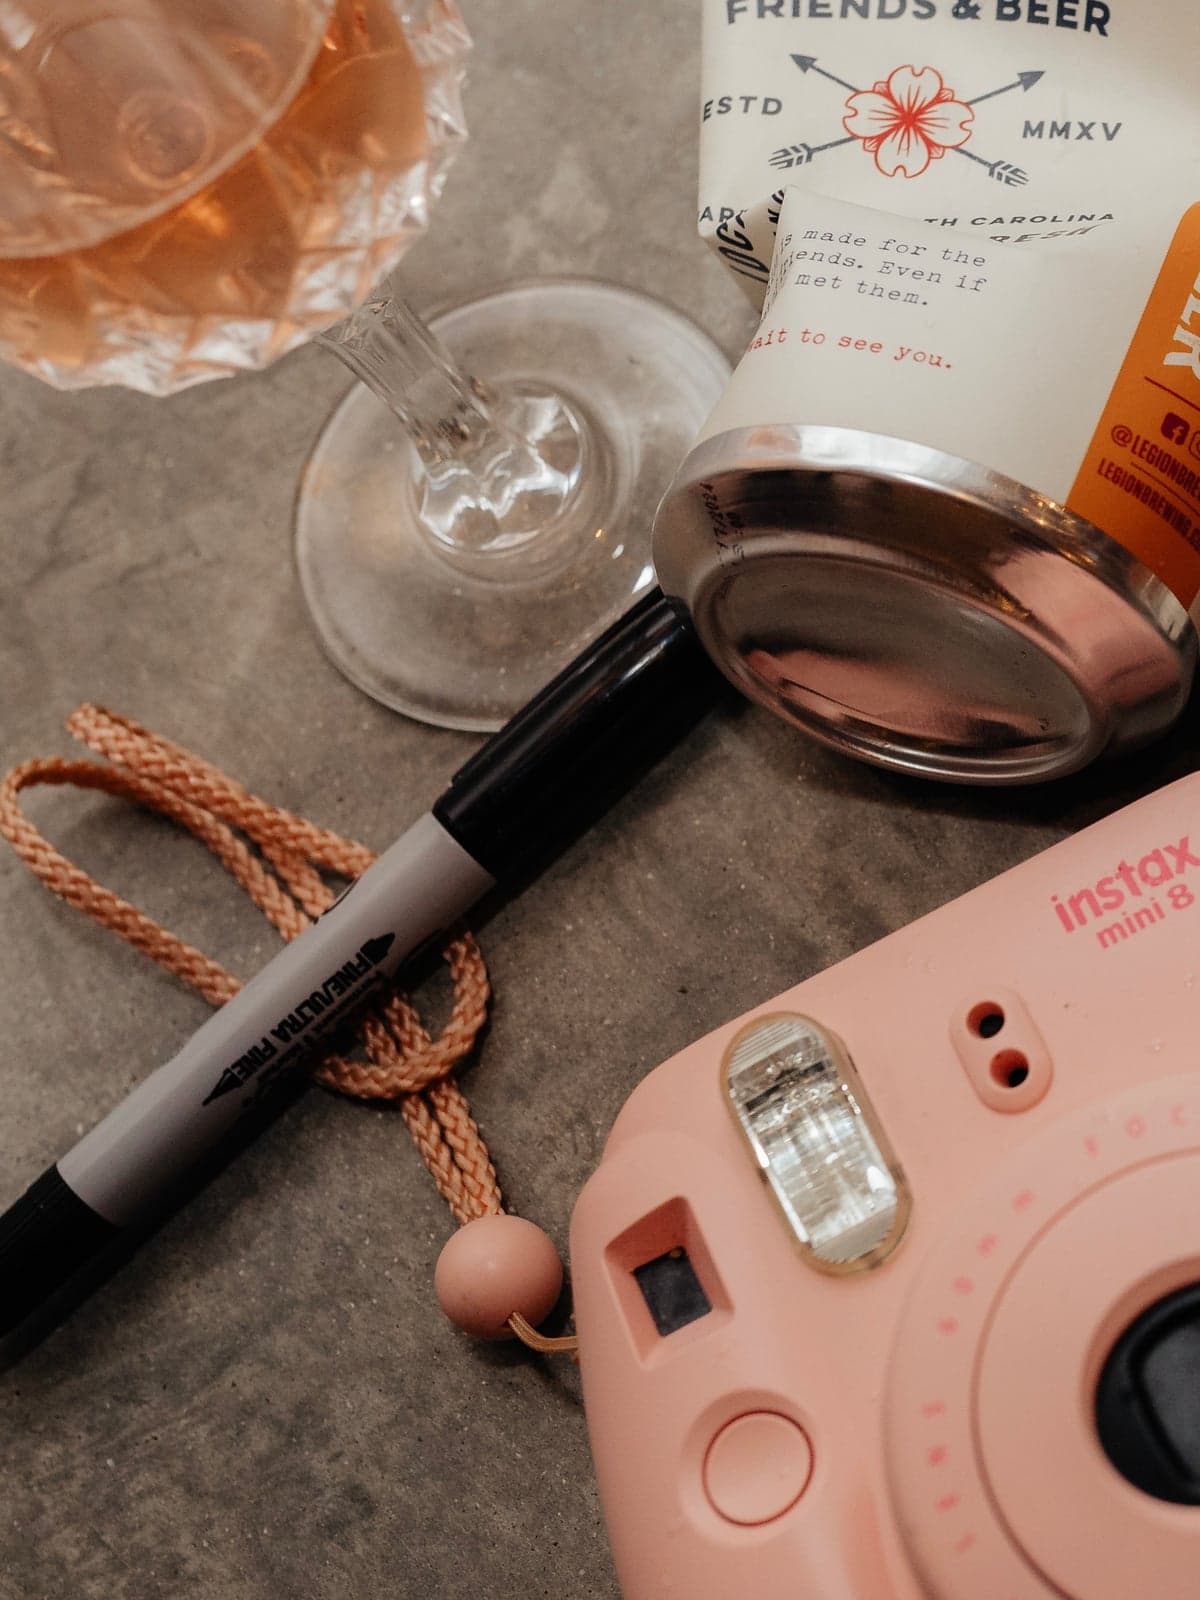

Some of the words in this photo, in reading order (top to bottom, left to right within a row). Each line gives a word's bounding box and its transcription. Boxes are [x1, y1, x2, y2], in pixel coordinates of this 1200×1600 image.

[726, 0, 937, 24] FRIENDS
[951, 0, 982, 20] &
[994, 0, 1111, 38] BEER
[703, 95, 783, 122] ESTD
[1022, 120, 1122, 142] MMXV
[970, 213, 1115, 226] CAROLINA
[801, 228, 867, 248] made
[878, 238, 928, 257] for
[941, 248, 987, 268] the
[794, 272, 843, 290] met
[857, 280, 929, 306] them.
[877, 260, 943, 284] Even
[955, 274, 988, 293] if
[800, 328, 827, 346] to
[838, 335, 884, 354] see
[893, 346, 953, 370] you.
[1096, 897, 1166, 950] mini
[1167, 883, 1196, 911] 8
[230, 1036, 276, 1081] FINE
